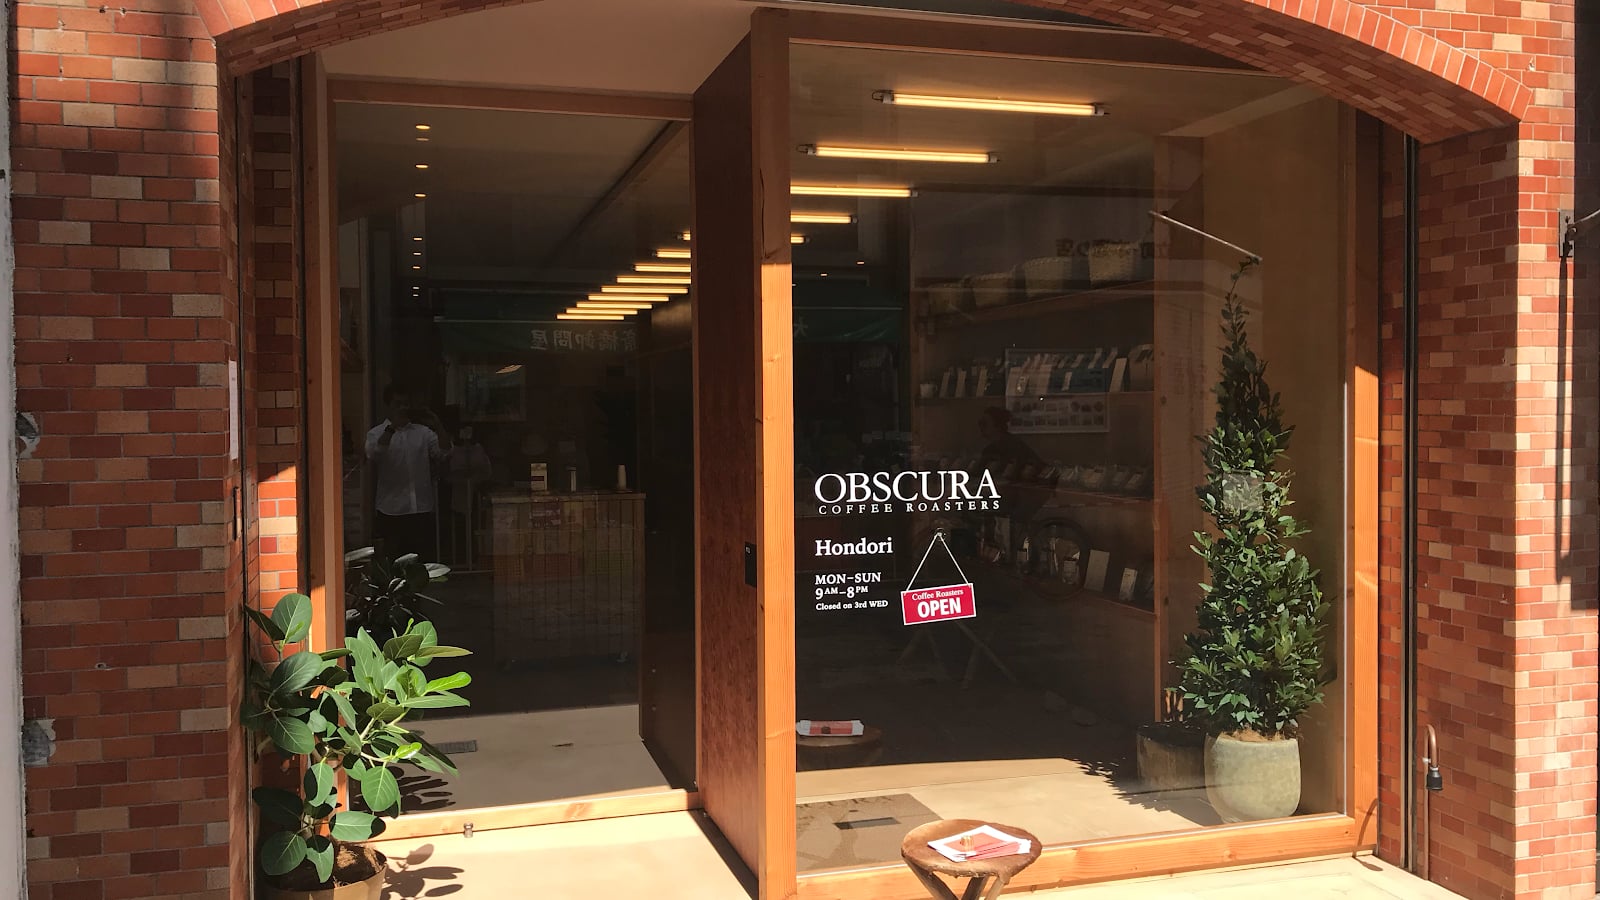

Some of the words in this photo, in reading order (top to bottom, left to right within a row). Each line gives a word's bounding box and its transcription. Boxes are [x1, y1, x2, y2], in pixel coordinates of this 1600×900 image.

[814, 469, 1001, 503] OBSCURA
[818, 503, 893, 515] COFFEE
[905, 501, 1000, 513] ROASTERS
[814, 536, 894, 556] Hondori
[911, 593, 935, 601] Coffee
[935, 589, 964, 598] Roasters
[815, 602, 841, 611] Closed
[854, 601, 868, 609] 3rd
[868, 600, 889, 608] WED
[917, 597, 962, 618] OPEN
